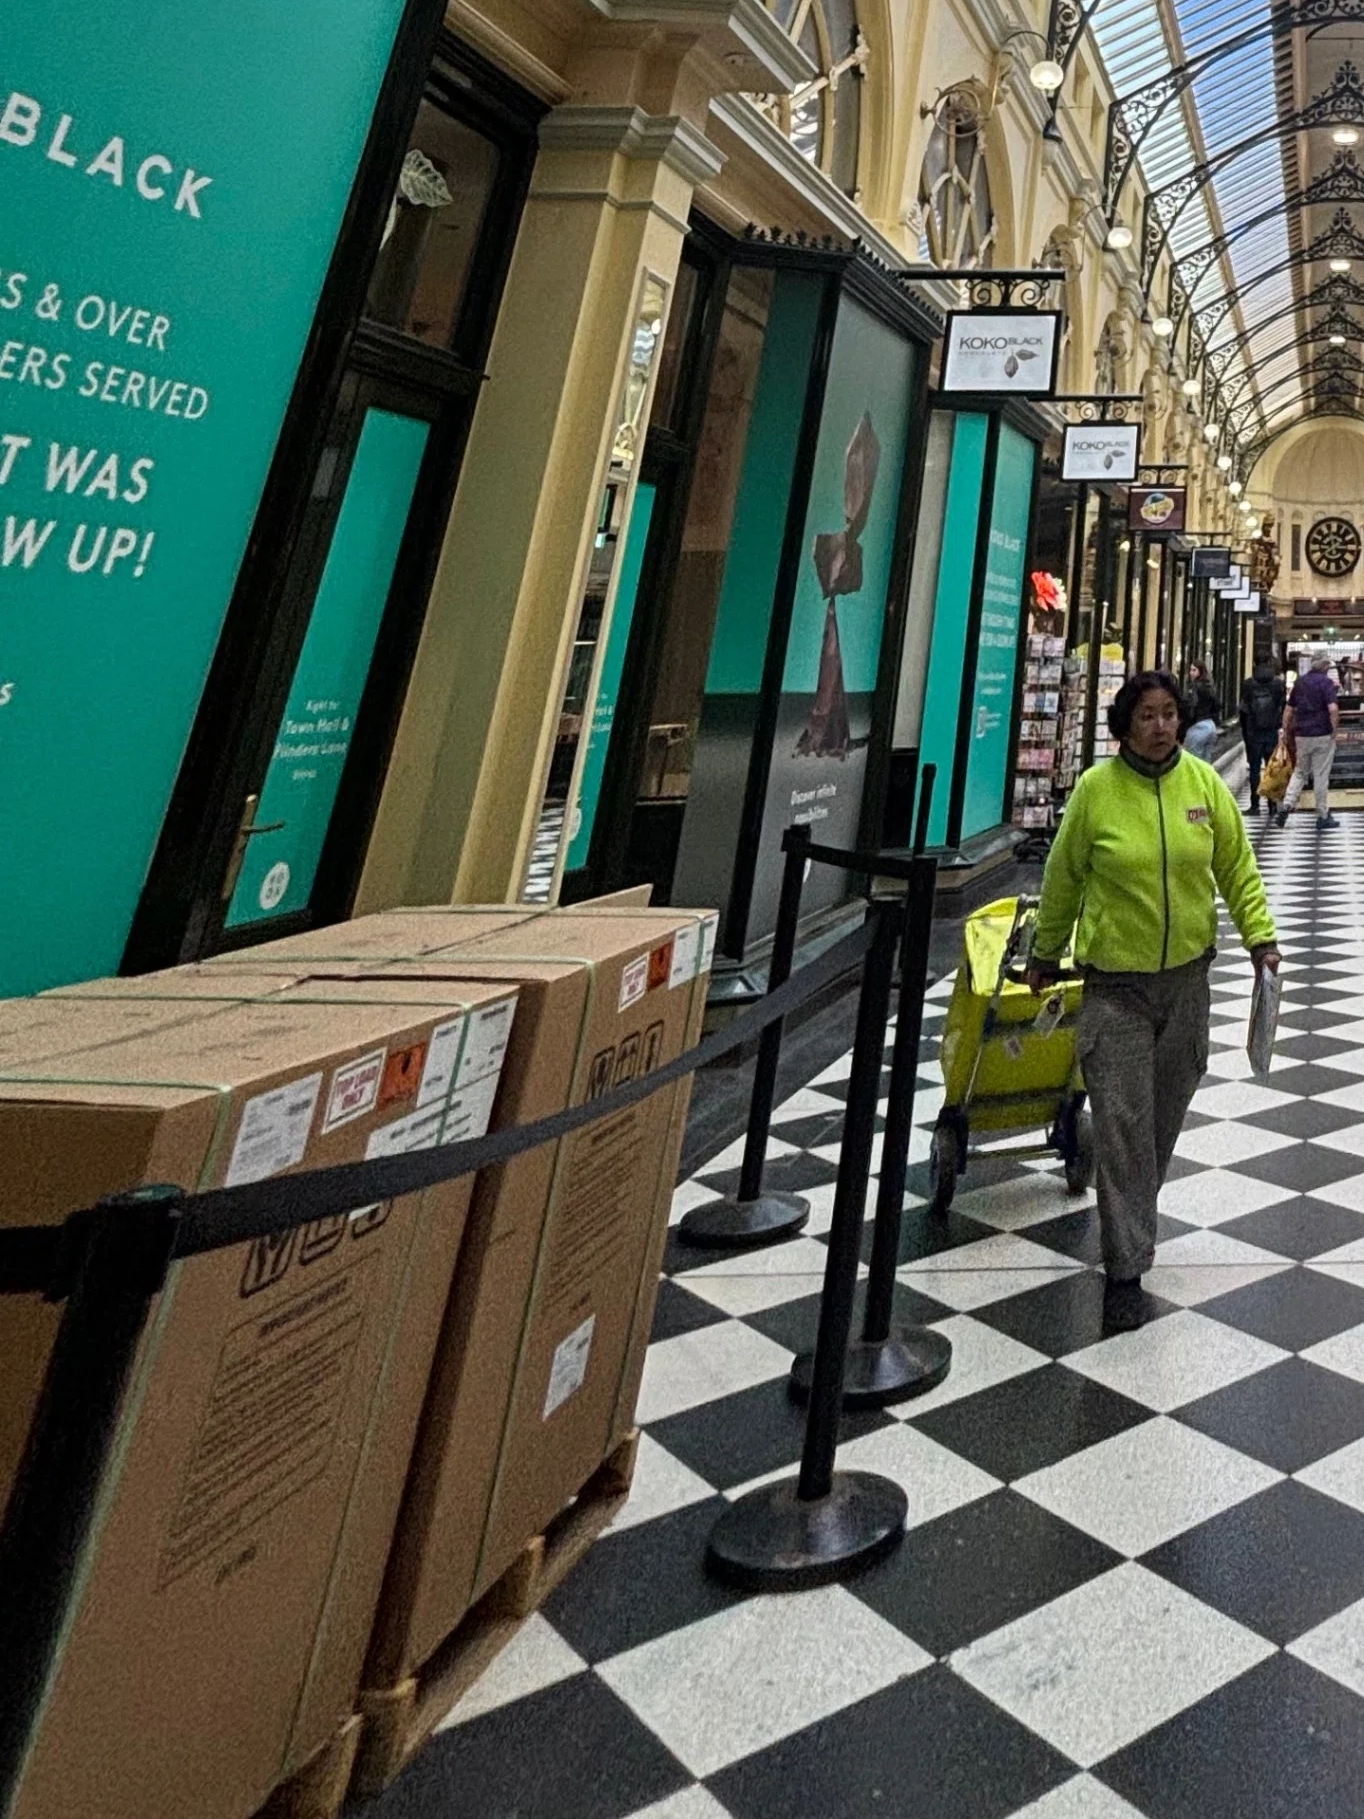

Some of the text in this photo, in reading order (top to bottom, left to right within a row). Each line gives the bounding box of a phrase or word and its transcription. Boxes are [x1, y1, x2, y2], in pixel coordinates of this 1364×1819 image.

[0, 92, 212, 218] BLACK
[35, 283, 62, 320] &
[75, 294, 170, 350] OVER
[960, 337, 1043, 350] KOKO BLACK
[79, 362, 208, 419] SERVED
[45, 442, 155, 504] WAS
[1073, 441, 1105, 451] KOKO
[68, 524, 155, 577] UP!
